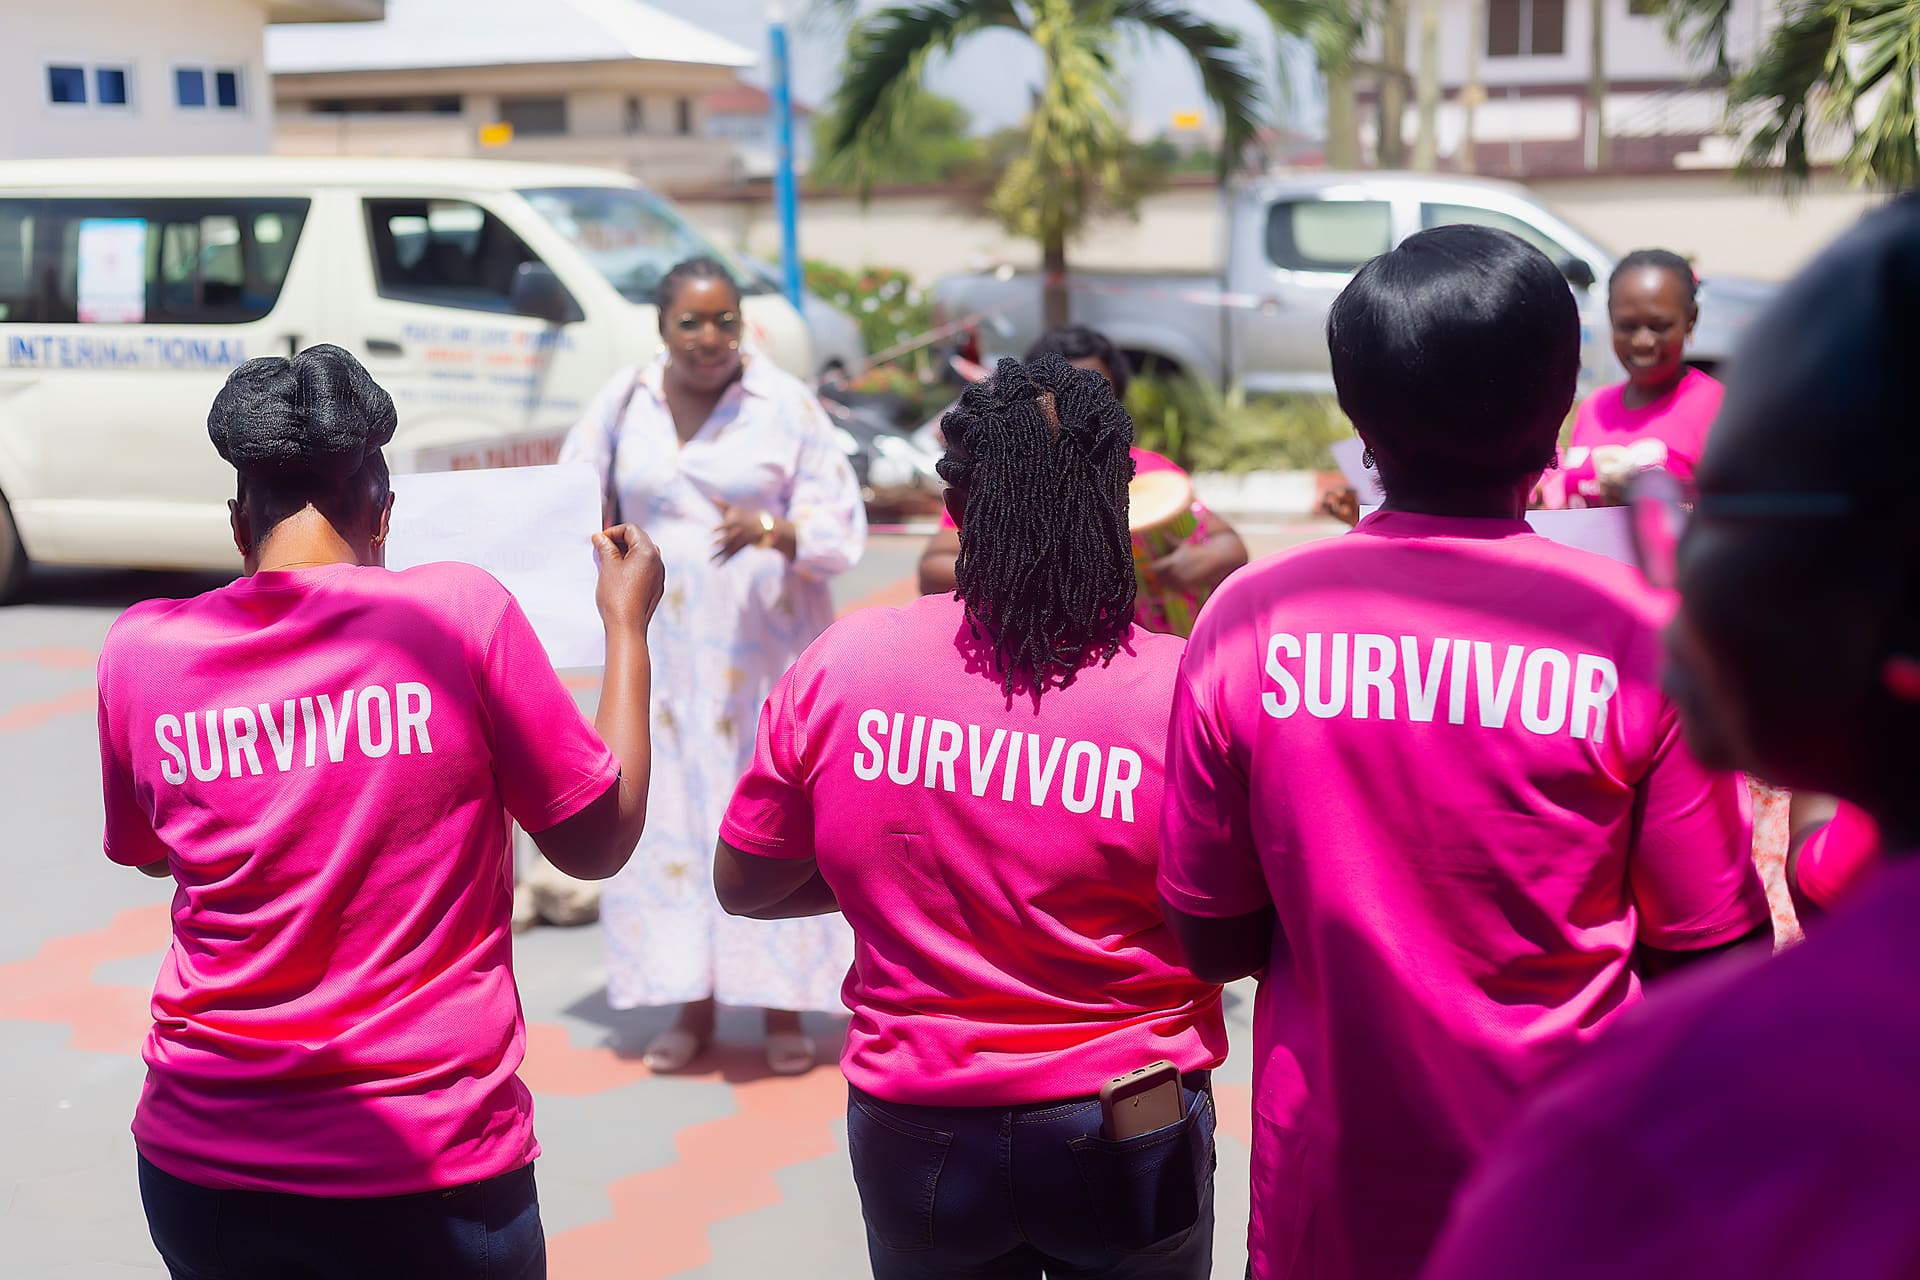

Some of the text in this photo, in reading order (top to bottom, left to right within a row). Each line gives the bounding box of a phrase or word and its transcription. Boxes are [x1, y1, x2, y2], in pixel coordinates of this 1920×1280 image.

[8, 335, 248, 368] INTERNATIONAL
[154, 681, 433, 786] SURVIVOR
[1261, 632, 1619, 744] SURVIVOR
[853, 708, 1143, 823] SURVIVOR
